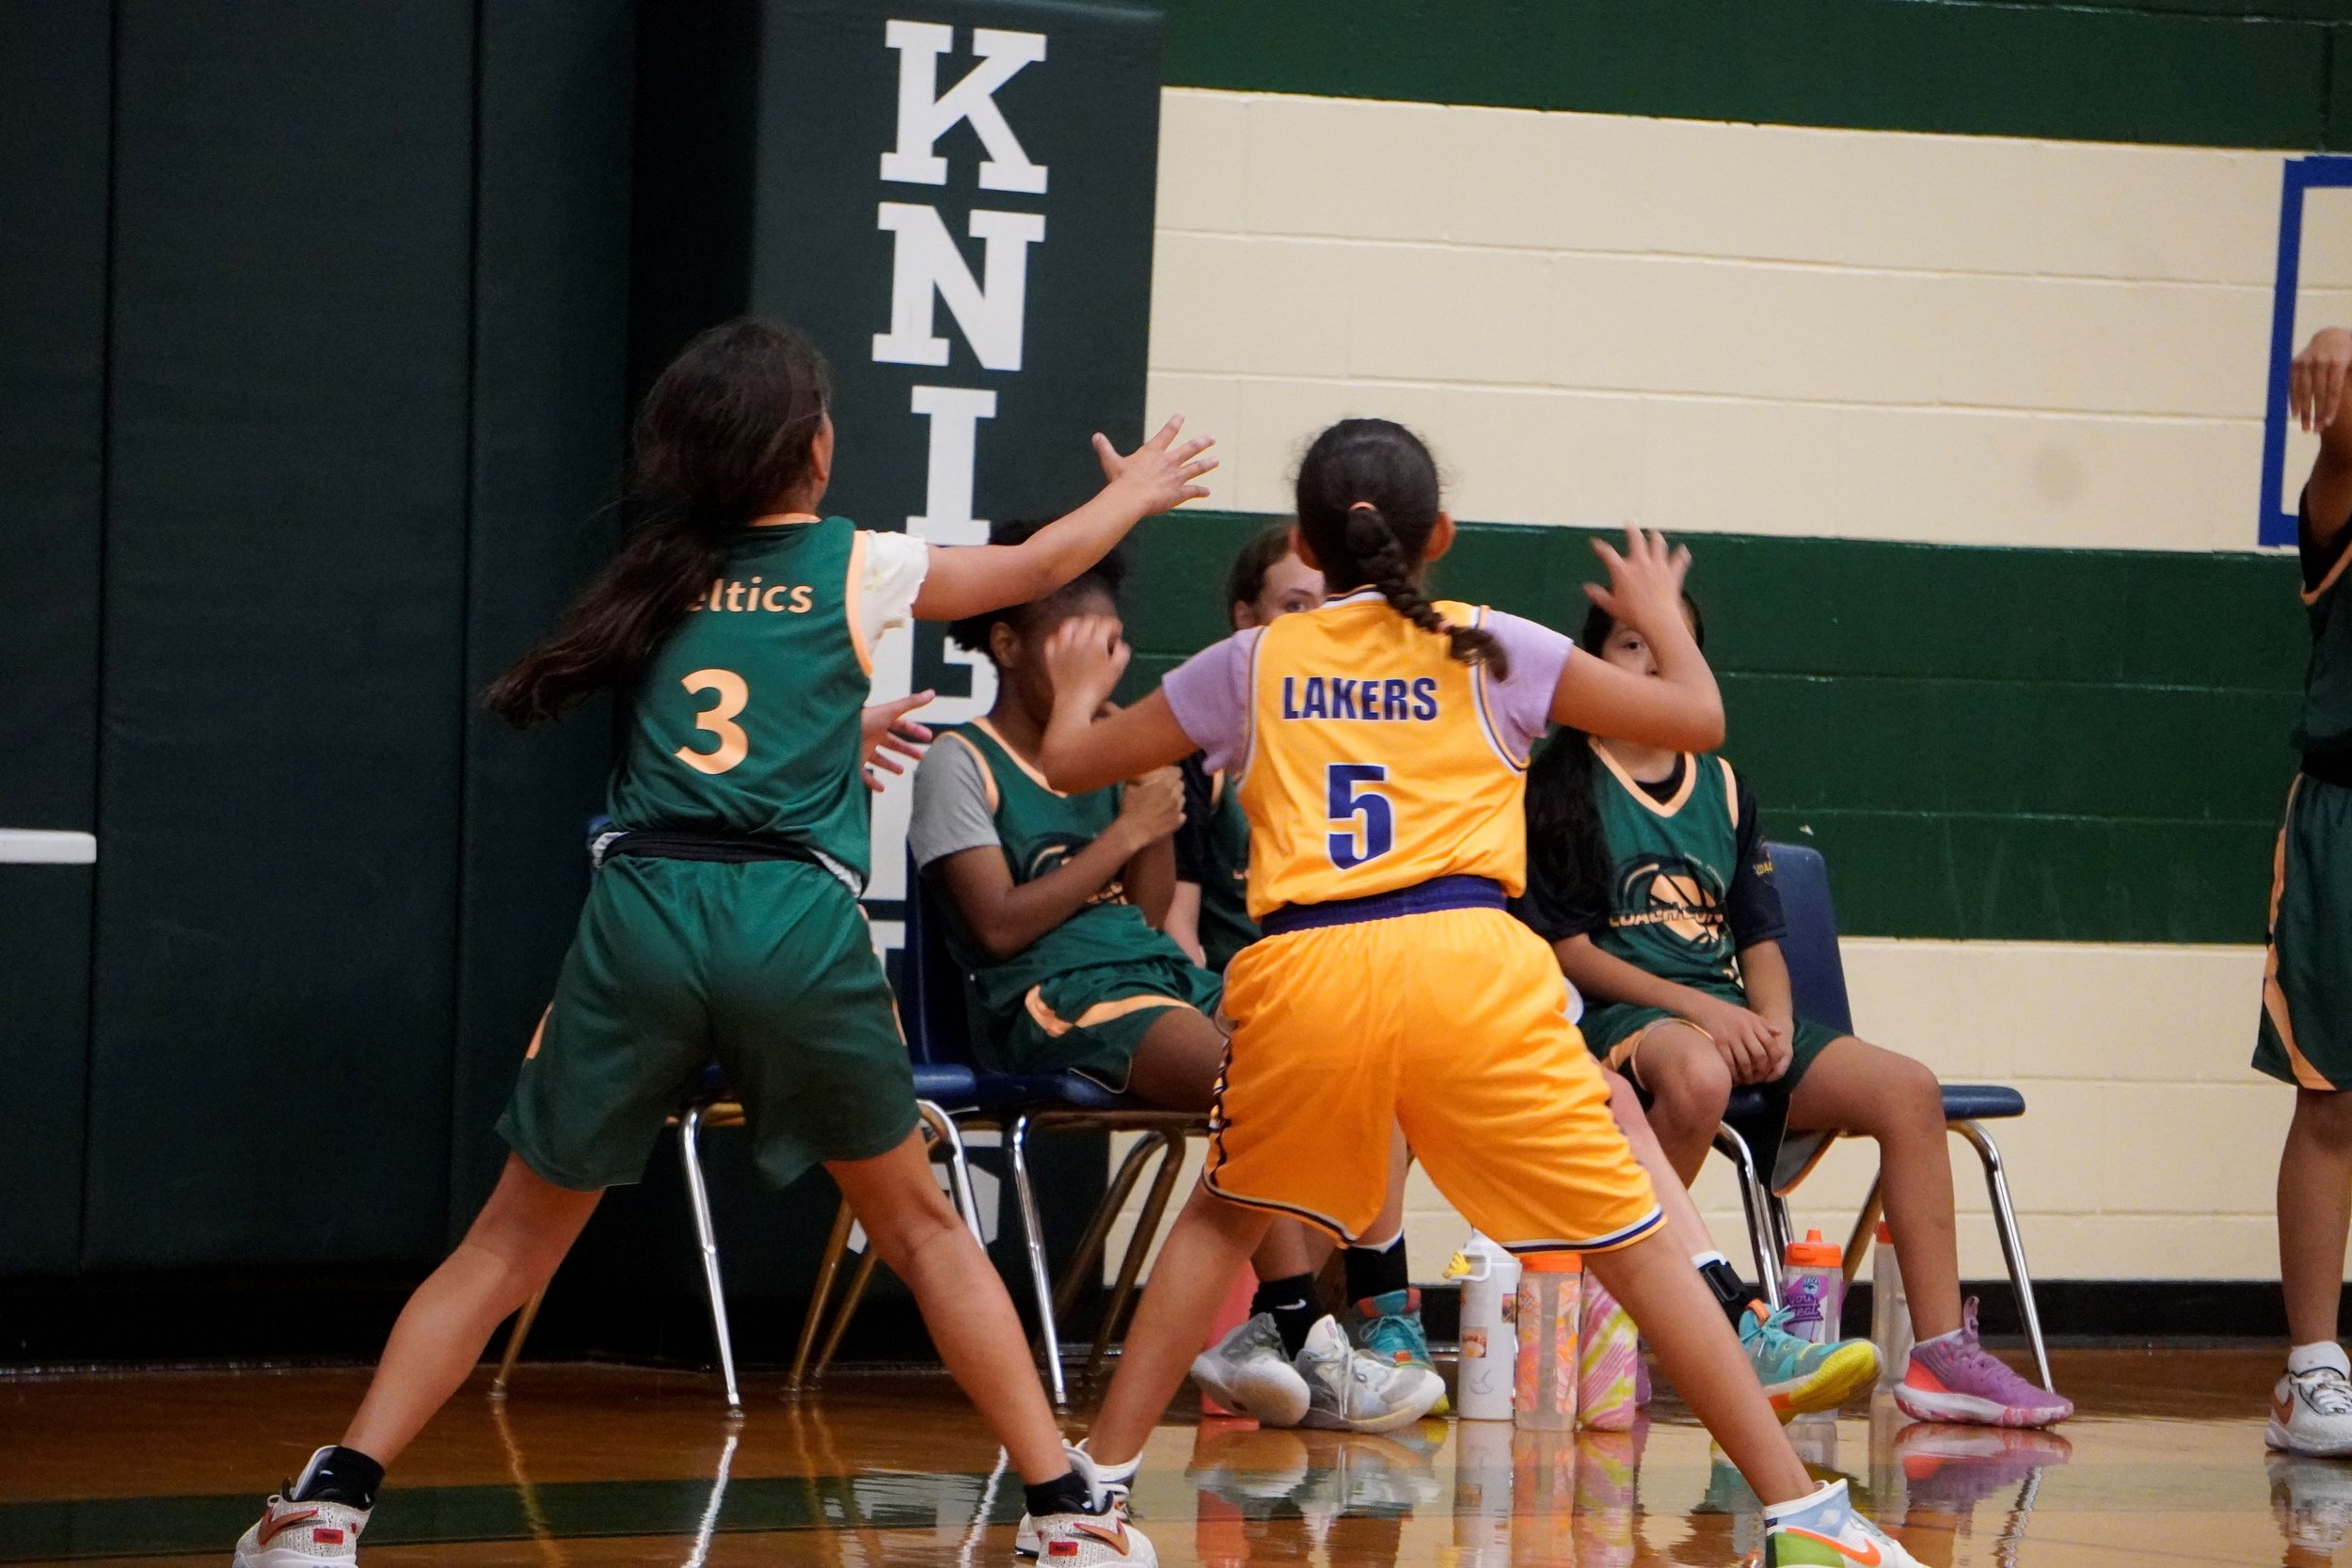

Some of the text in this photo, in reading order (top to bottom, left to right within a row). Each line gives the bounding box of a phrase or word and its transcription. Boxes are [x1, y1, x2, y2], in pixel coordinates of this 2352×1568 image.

[686, 576, 814, 614] ltics
[675, 667, 750, 775] 3
[1282, 676, 1438, 721] LAKERS
[1327, 764, 1393, 870] 5
